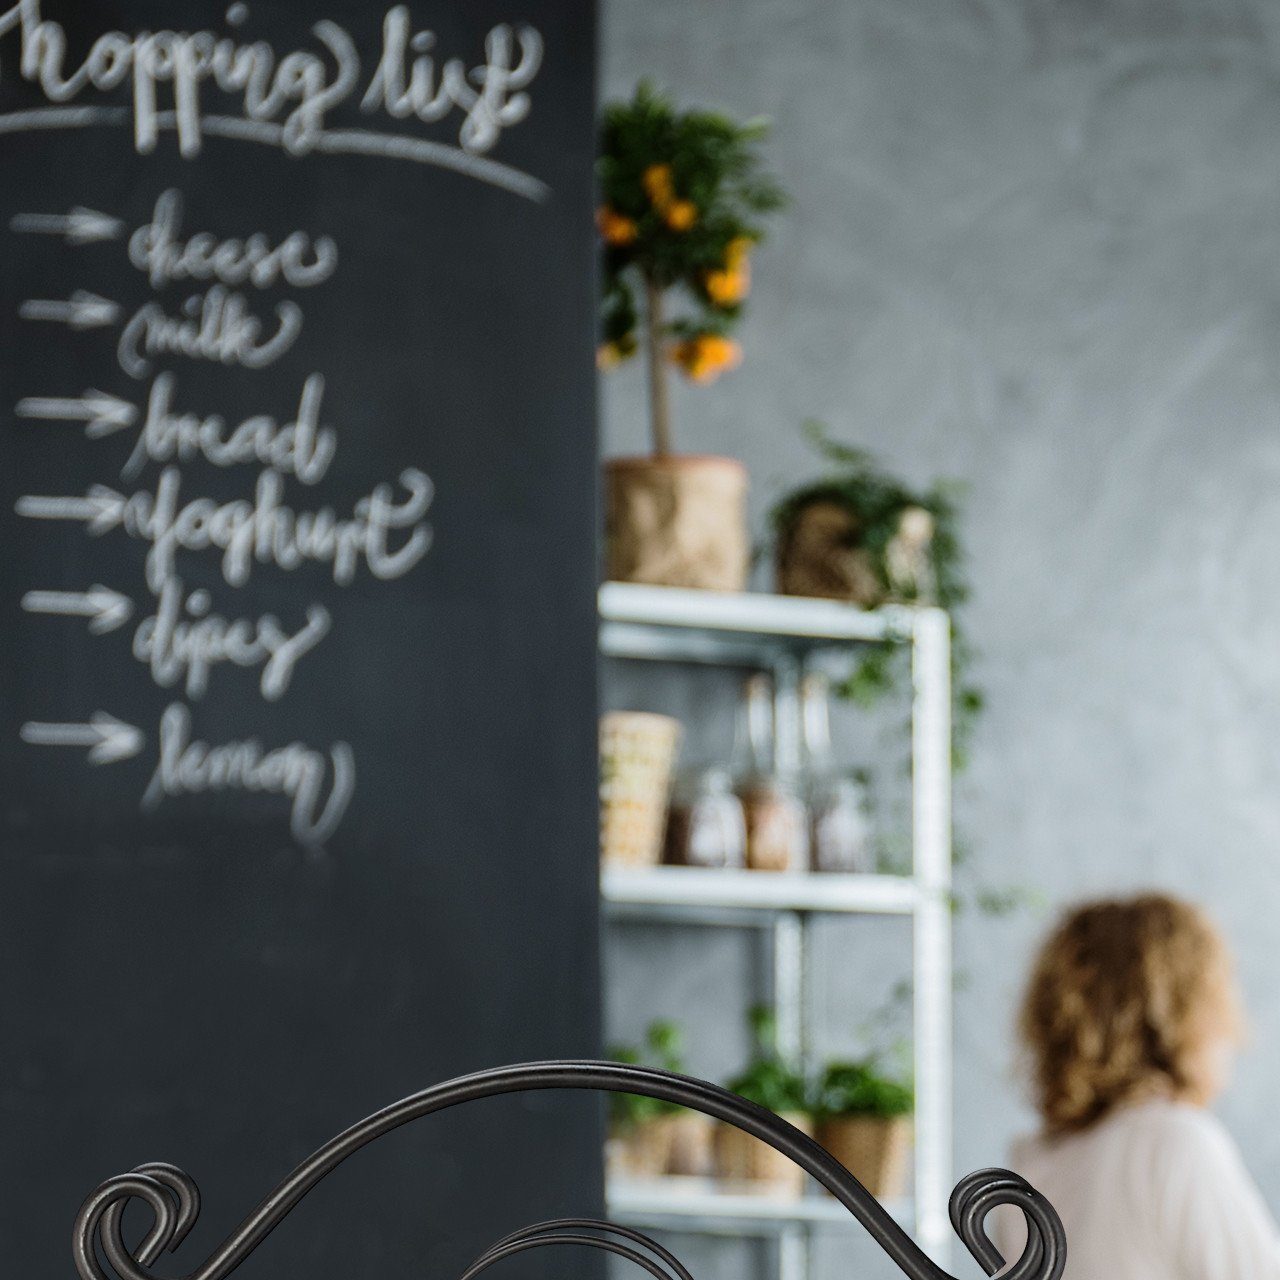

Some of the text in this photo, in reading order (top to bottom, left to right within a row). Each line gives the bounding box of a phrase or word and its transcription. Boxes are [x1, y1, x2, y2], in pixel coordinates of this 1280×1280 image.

[0, 0, 545, 158] hopping list
[127, 187, 339, 290] cheese
[117, 284, 303, 380] milk
[119, 371, 338, 485] bread
[123, 466, 436, 595] yoghurt
